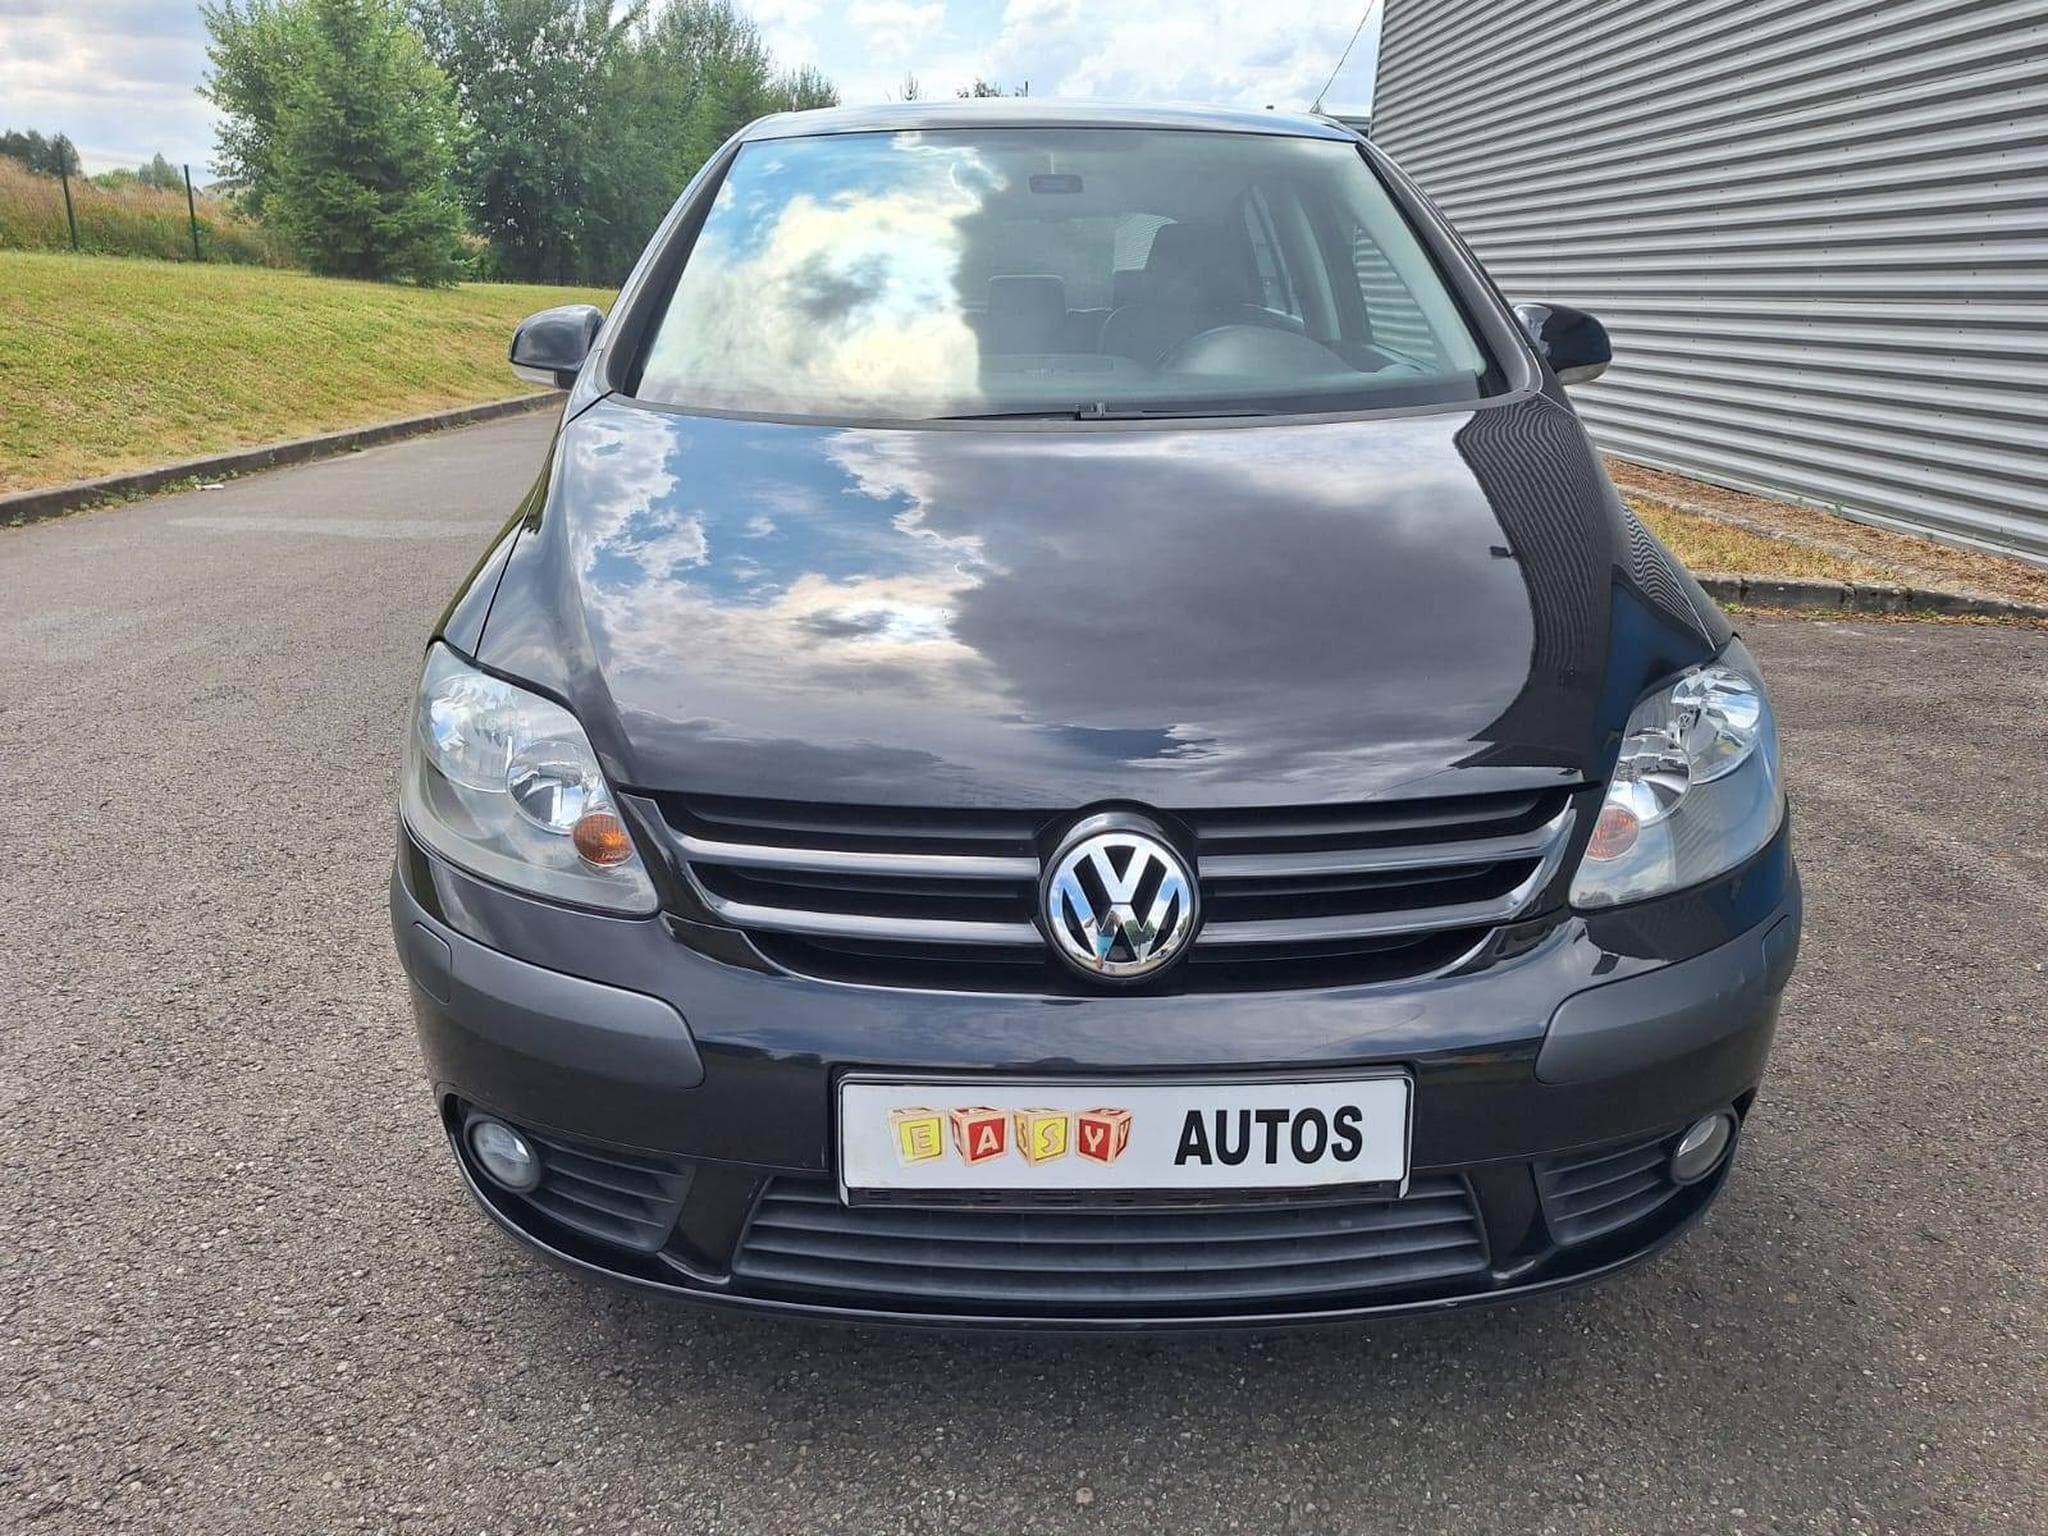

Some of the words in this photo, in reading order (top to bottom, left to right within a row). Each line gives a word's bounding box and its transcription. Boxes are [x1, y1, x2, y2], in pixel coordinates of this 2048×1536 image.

[1055, 838, 1185, 968] VW
[901, 1117, 1113, 1162] EASY
[1174, 1105, 1363, 1166] AUTOS
